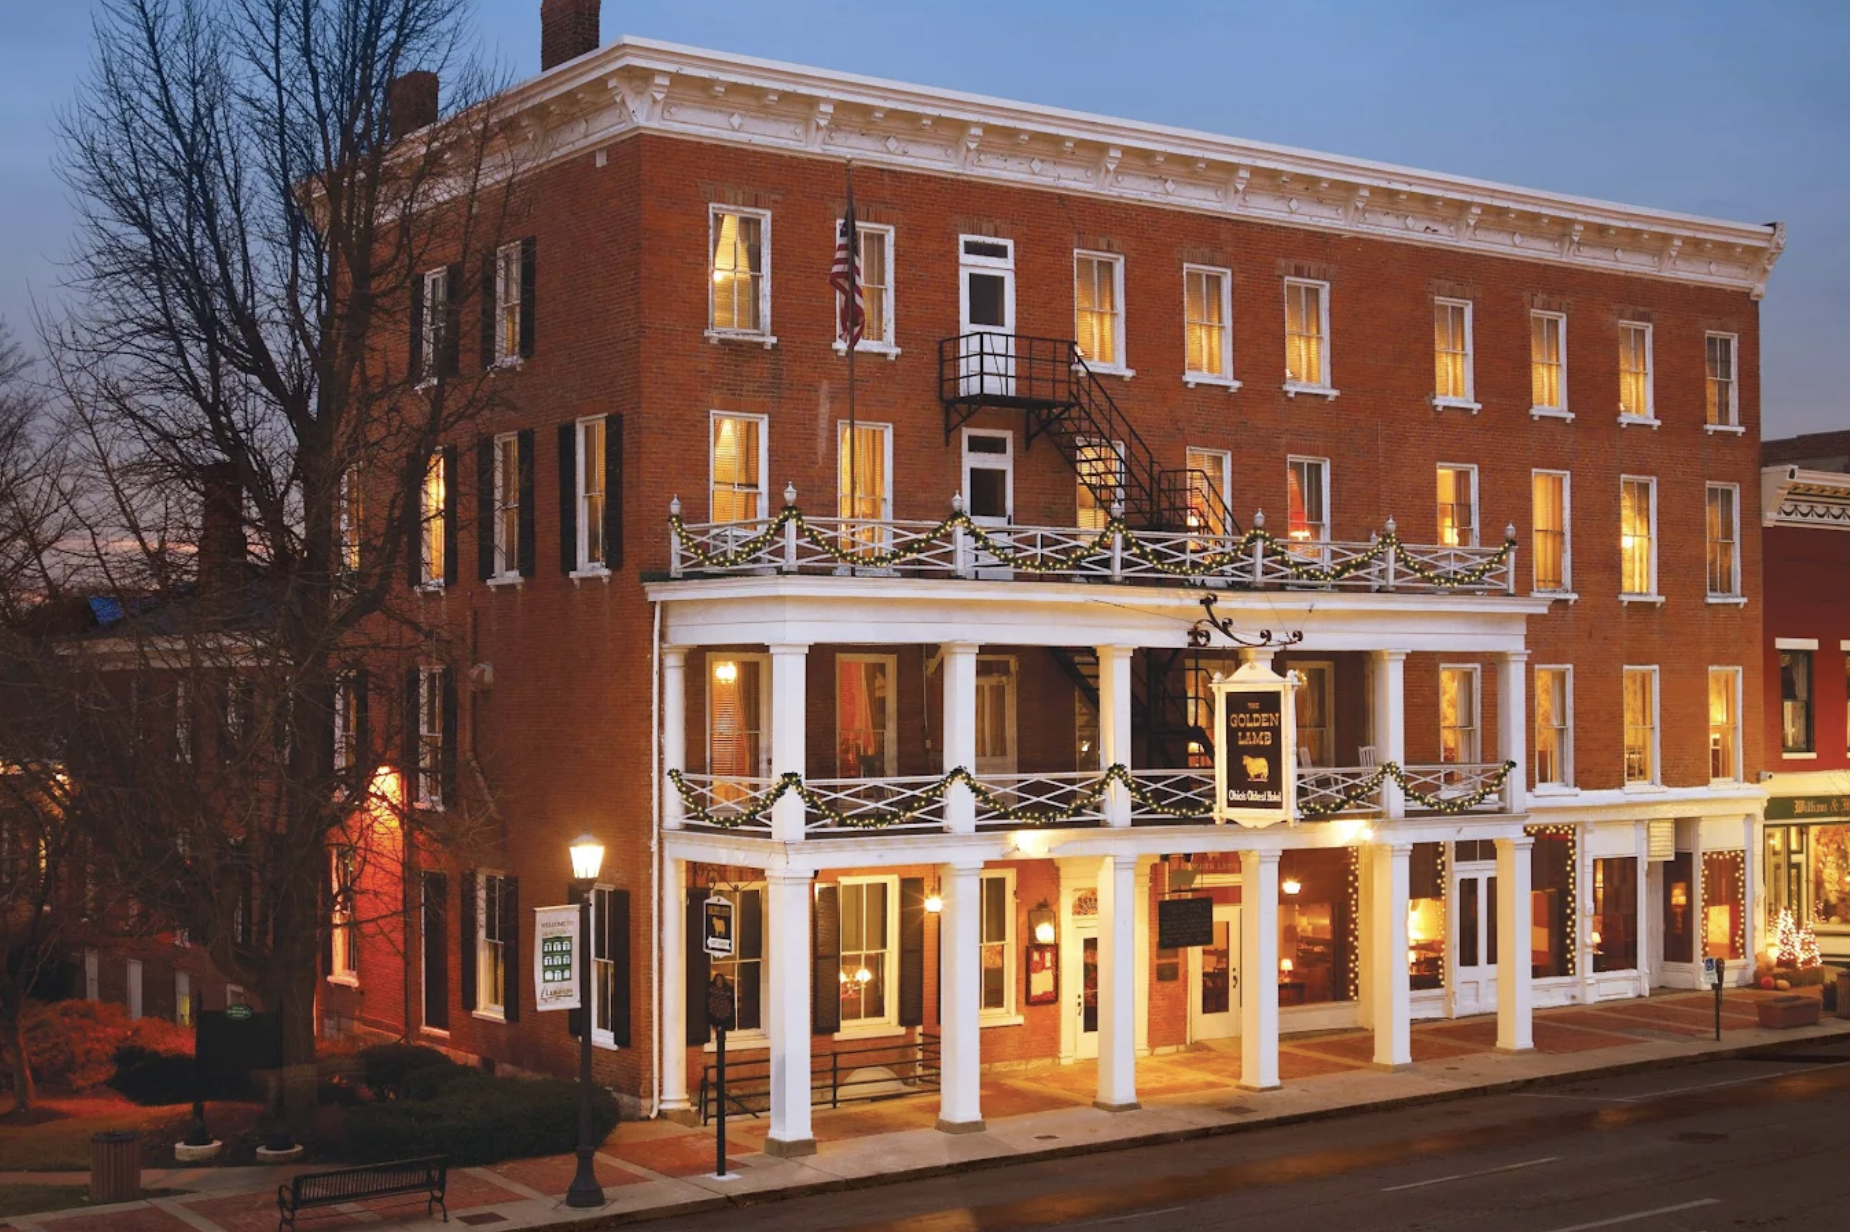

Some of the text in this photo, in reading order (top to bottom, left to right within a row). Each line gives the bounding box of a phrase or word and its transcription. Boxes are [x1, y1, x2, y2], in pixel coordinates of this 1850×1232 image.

[1247, 702, 1260, 710] THE
[1229, 713, 1279, 727] GOLDEN
[1238, 731, 1272, 745] LAMB
[1247, 789, 1266, 803] Oldest
[1267, 791, 1281, 804] Hotel
[1793, 799, 1827, 814] William
[1831, 798, 1839, 813] &
[541, 921, 566, 929] WELCOME
